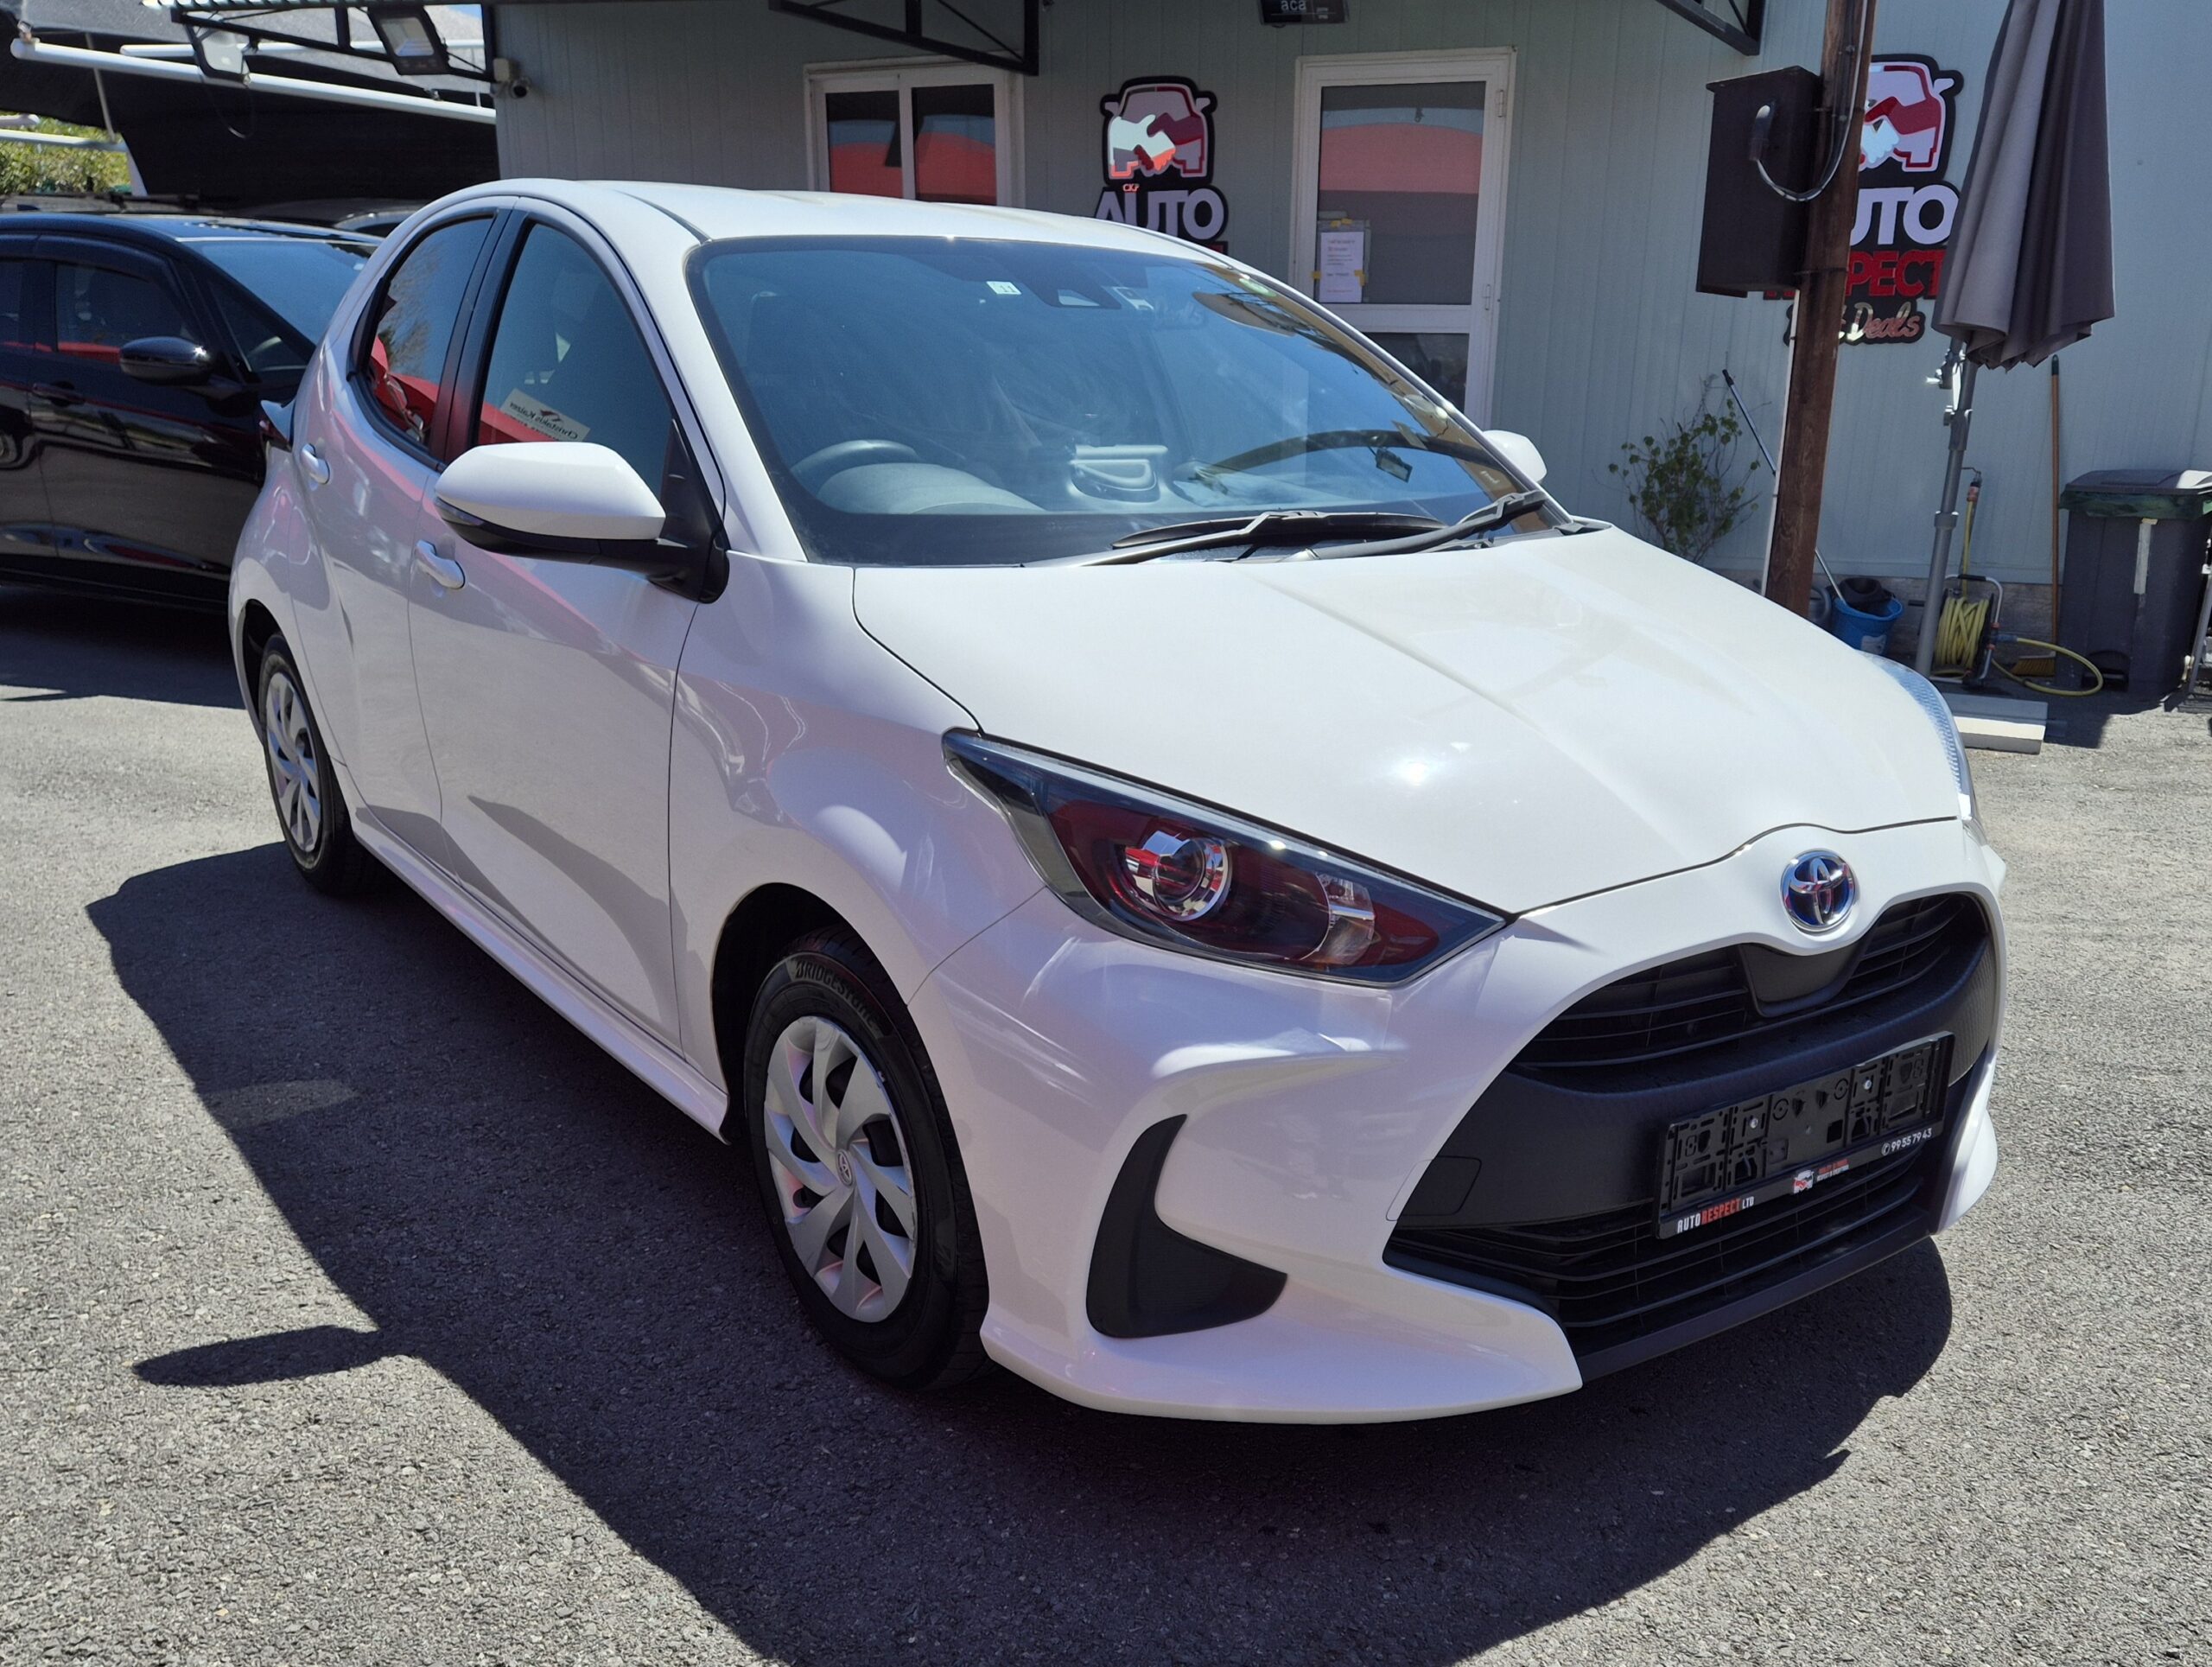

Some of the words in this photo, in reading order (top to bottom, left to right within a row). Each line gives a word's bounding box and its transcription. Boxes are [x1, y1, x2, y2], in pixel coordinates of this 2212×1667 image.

[1096, 188, 1224, 239] AUTO
[1850, 184, 1959, 246] UTO
[1846, 302, 1920, 341] Deals
[1742, 1196, 1755, 1209] LTD
